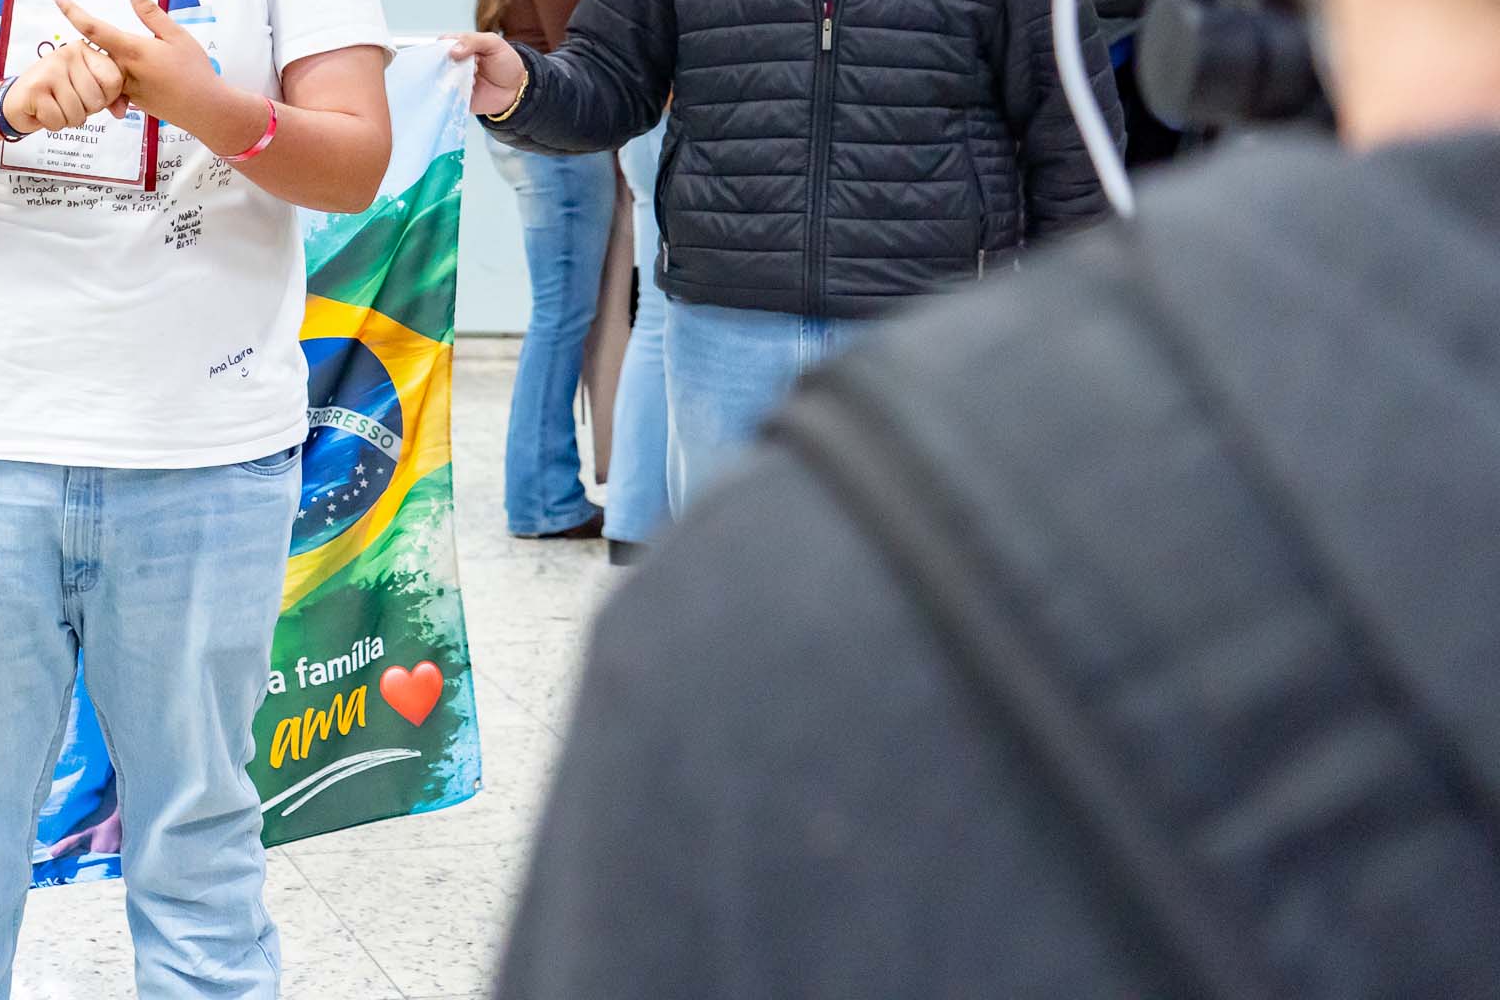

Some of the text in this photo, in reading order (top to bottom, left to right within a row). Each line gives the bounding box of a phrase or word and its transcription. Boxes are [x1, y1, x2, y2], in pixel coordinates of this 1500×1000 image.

[46, 131, 98, 144] VOLTARELLI
[12, 184, 59, 196] obrigado
[63, 185, 78, 195] por
[26, 197, 62, 206] melhor
[210, 362, 228, 379] Ana
[295, 636, 385, 689] família
[269, 685, 367, 769] ama
